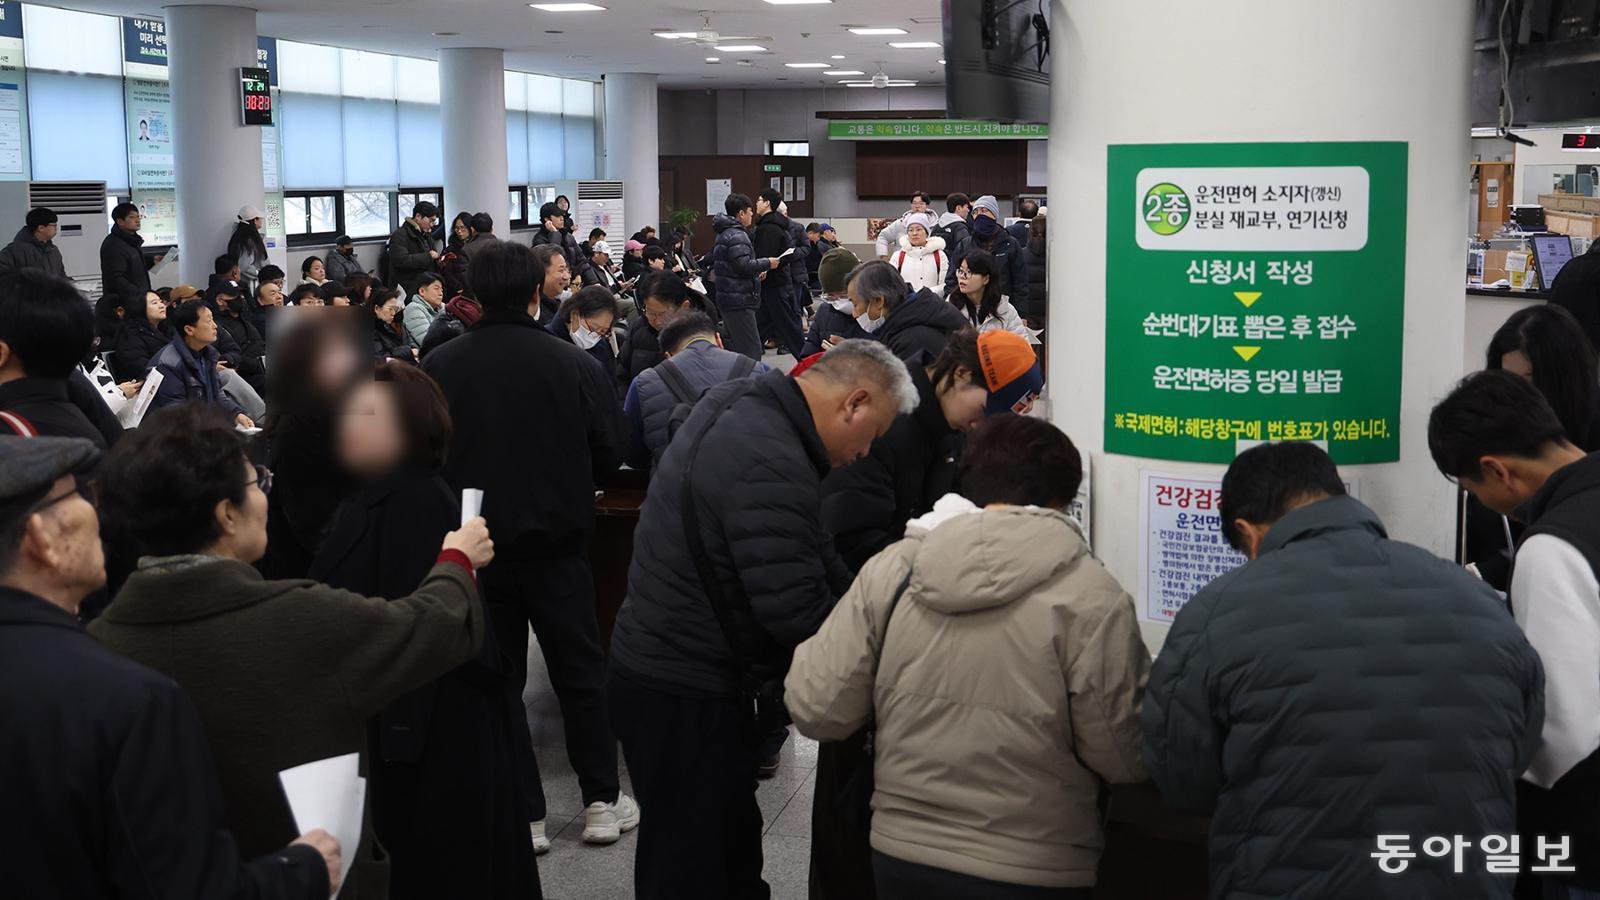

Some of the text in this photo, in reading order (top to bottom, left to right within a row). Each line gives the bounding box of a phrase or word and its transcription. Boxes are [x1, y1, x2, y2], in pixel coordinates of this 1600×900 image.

[140, 32, 154, 45] 미리
[848, 124, 874, 135] 교통은
[927, 124, 952, 135] 약속은
[954, 123, 981, 135] 반드시
[983, 123, 1010, 134] 지켜야
[1577, 135, 1586, 147] 3
[1195, 185, 1342, 204] 운전면허 소지자(갱신)
[1145, 193, 1189, 227] 2종
[1195, 210, 1348, 230] 분실 재교부, 연기신청
[1186, 259, 1313, 285] 신청서 작성
[1142, 312, 1357, 339] 순번대기표 뽑은 후 접수
[1153, 365, 1343, 393] 운전면허증 당일 발급
[1267, 420, 1329, 440] 번호표가
[1333, 419, 1390, 440] 있습니다.
[1176, 512, 1222, 531] 운전면
[1160, 530, 1191, 541] 건강검진
[1159, 569, 1190, 581] 건강검진
